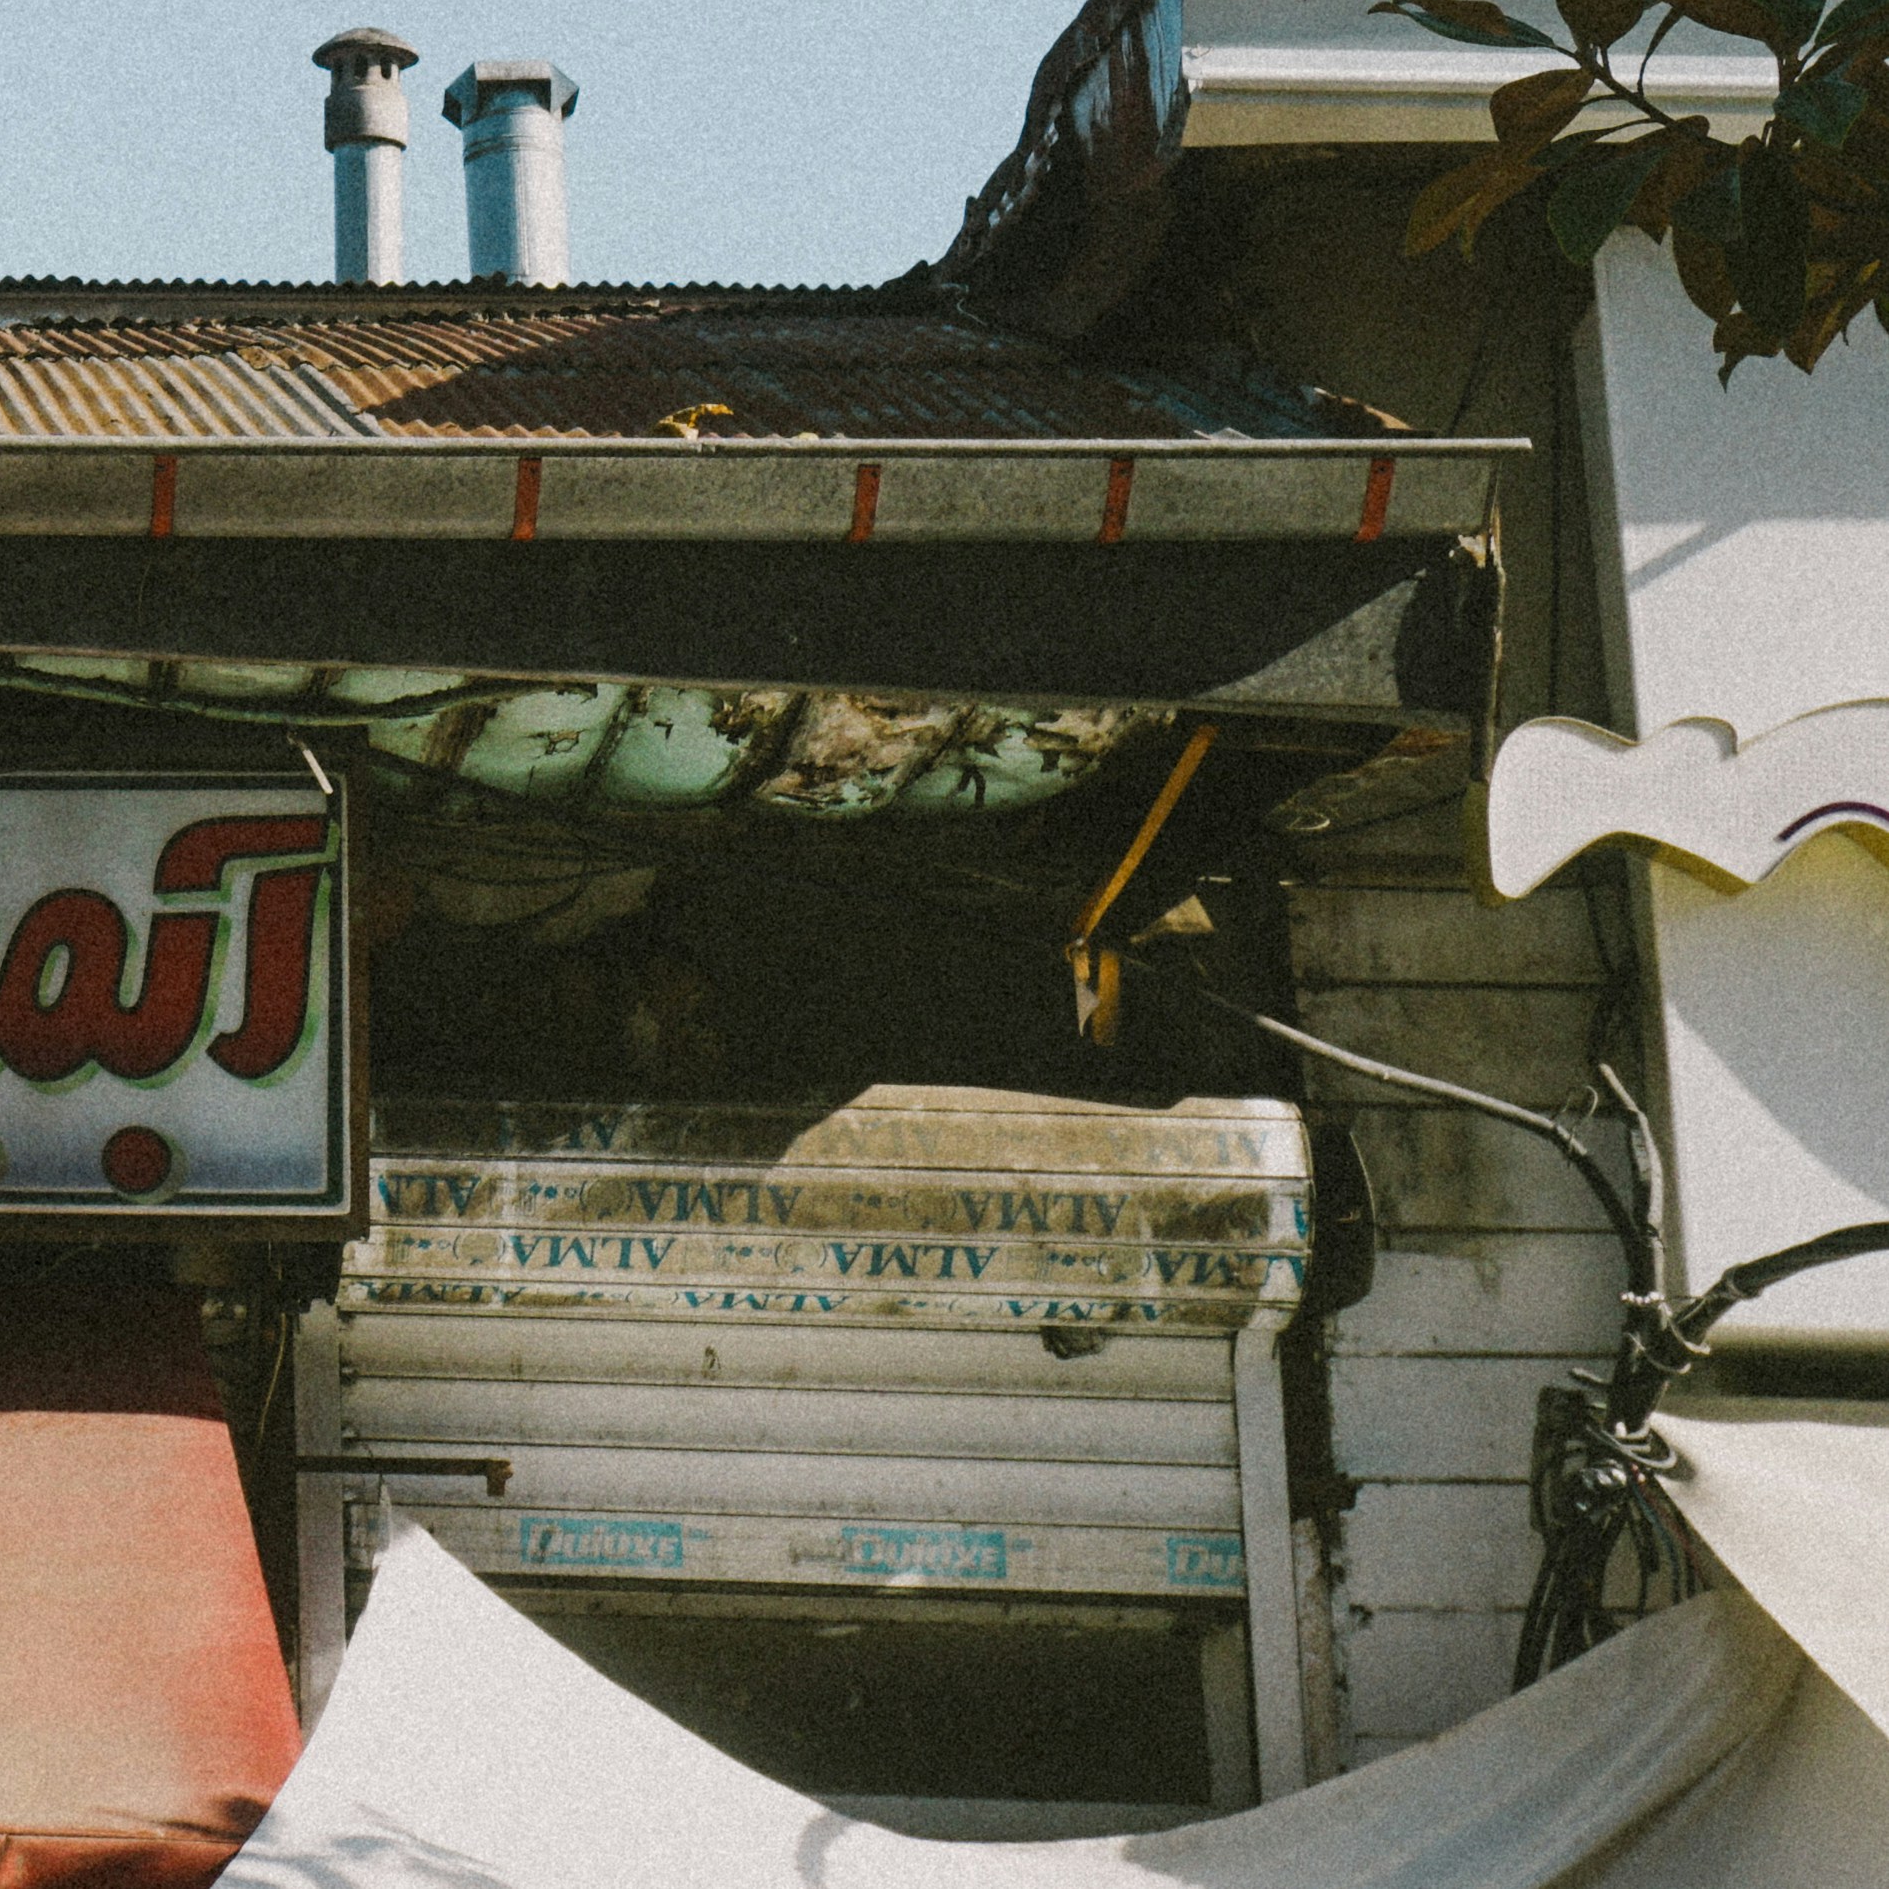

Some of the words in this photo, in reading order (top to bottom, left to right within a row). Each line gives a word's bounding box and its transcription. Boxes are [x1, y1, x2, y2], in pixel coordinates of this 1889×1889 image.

[630, 1179, 803, 1224] ALMA
[956, 1189, 1130, 1237] ALMA
[510, 1235, 676, 1270] ALMA
[828, 1242, 1000, 1280] ALMA
[680, 1290, 851, 1312] ALMA
